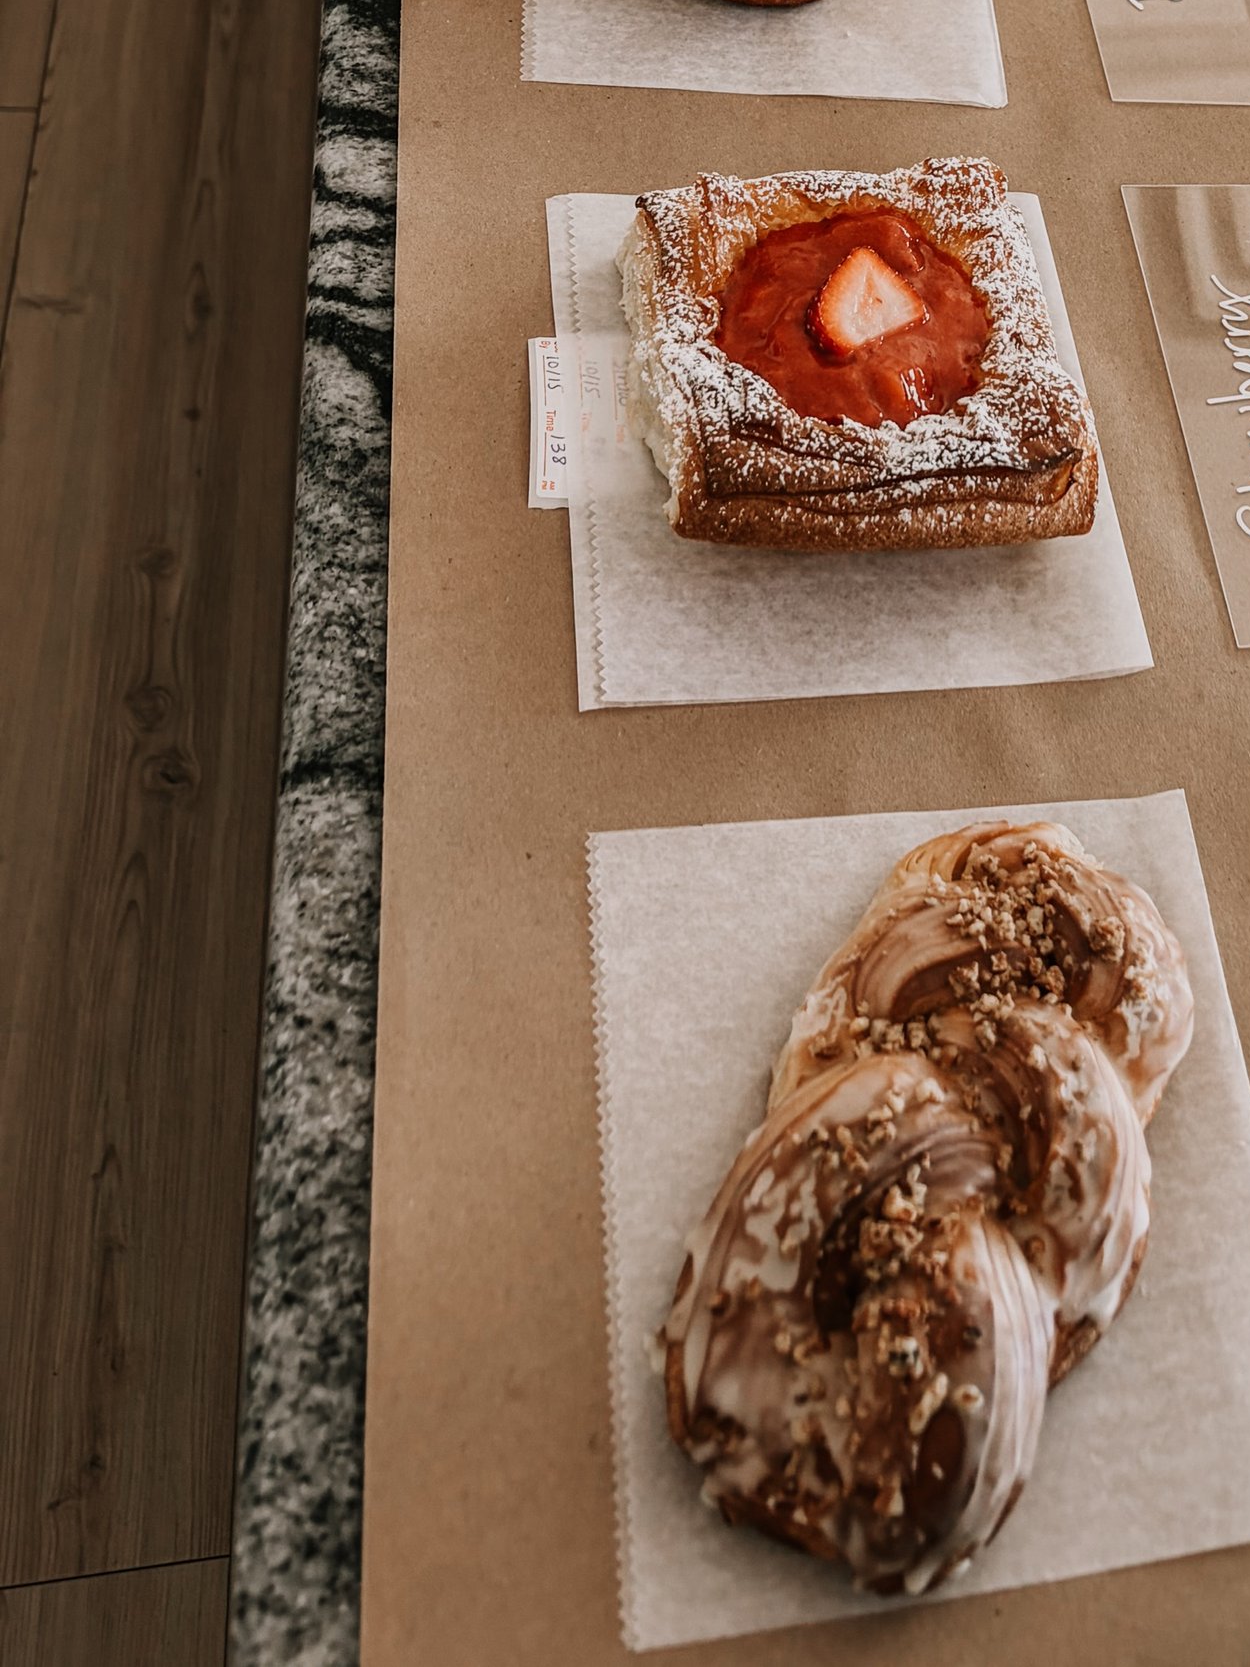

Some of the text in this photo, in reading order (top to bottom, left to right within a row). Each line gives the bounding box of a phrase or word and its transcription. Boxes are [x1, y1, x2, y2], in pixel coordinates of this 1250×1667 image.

[546, 355, 562, 392] 10/15
[546, 410, 556, 432] Time
[550, 434, 567, 466] 138
